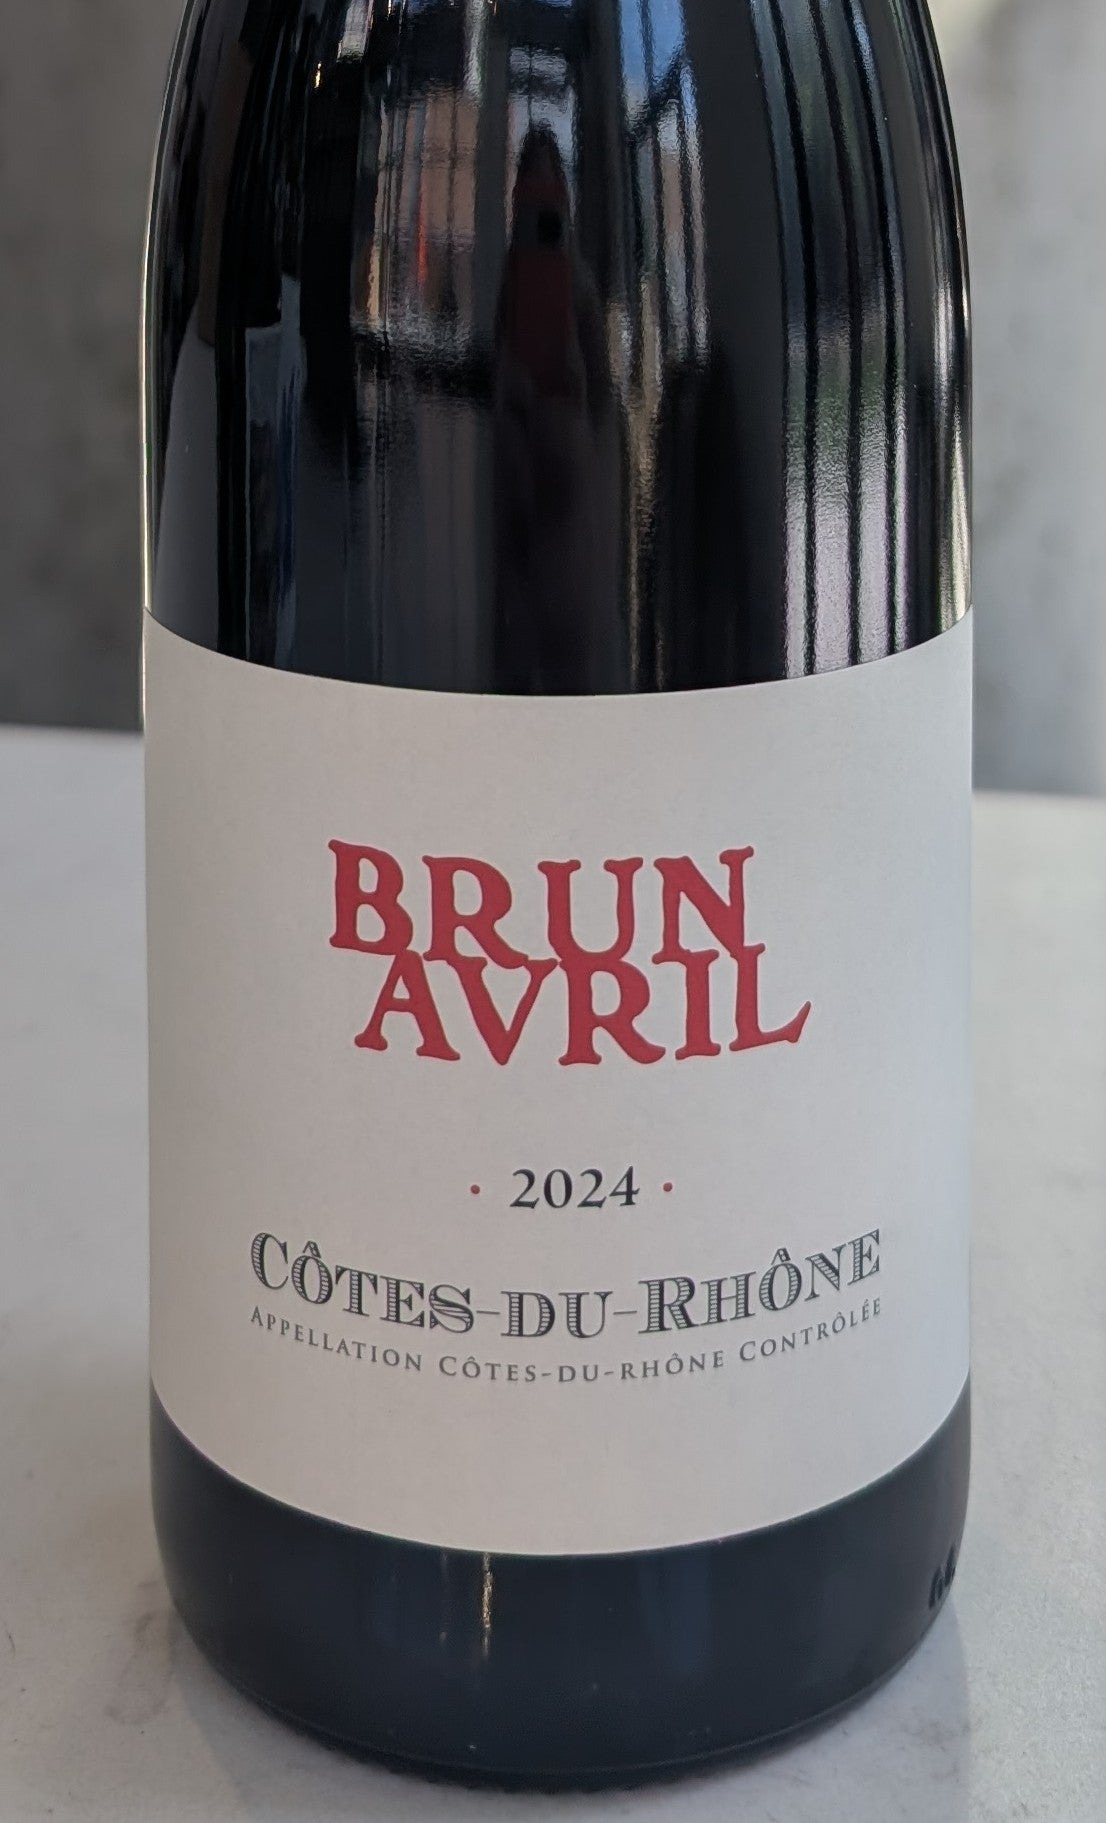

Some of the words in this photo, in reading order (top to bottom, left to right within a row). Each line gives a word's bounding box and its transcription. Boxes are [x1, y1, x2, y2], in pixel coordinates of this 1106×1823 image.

[328, 839, 755, 969] BRUN
[354, 942, 812, 1066] AVRIL
[509, 1165, 641, 1210] 2024
[250, 1228, 881, 1340] CÔTES-DU-RHÔNE
[250, 1305, 424, 1372] APPELLATION
[438, 1351, 725, 1384] CÔTES-DU-RHÔNE
[739, 1297, 882, 1363] CONTRÔLÉE
